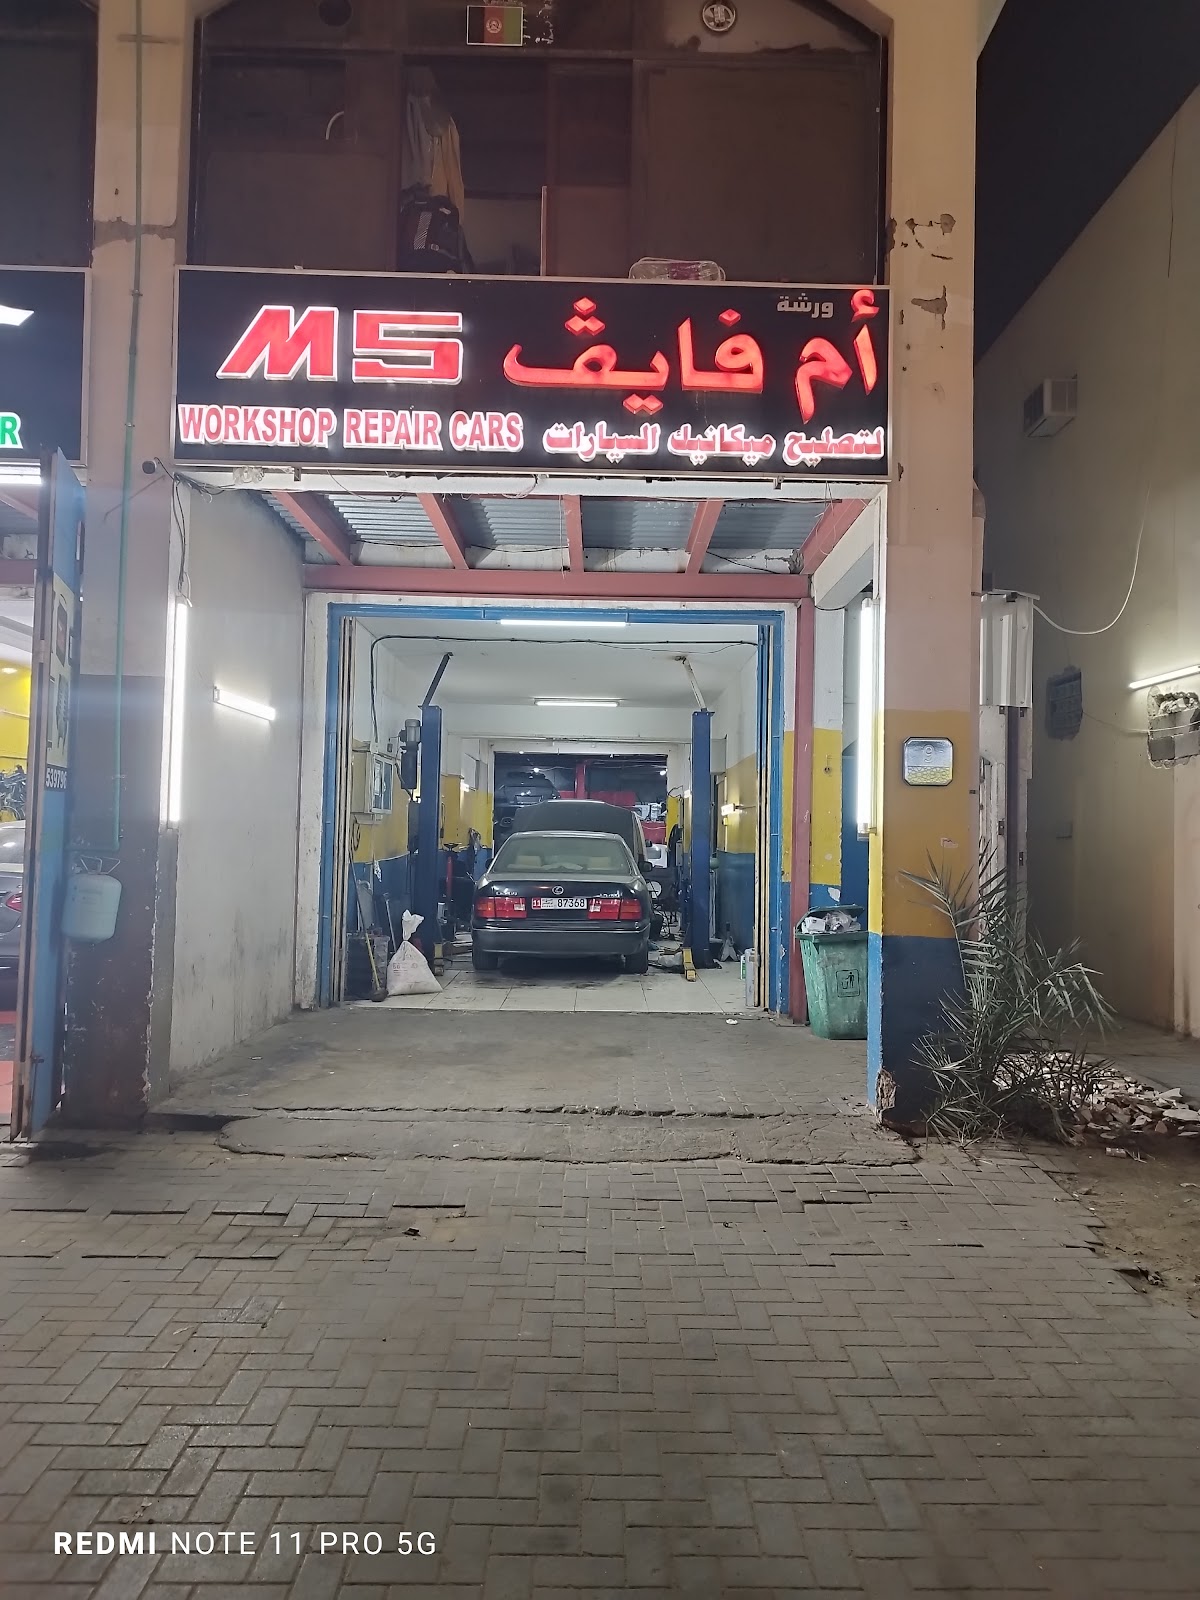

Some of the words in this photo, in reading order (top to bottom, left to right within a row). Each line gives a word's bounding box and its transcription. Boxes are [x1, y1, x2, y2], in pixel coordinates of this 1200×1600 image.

[776, 292, 834, 319] ورشة
[794, 288, 880, 425] أم
[178, 404, 337, 448] WORKSHOP
[343, 409, 443, 450] REPAIR
[449, 410, 524, 452] CARS
[542, 421, 661, 464] السيارات
[667, 422, 777, 466] ميكانيك
[782, 426, 885, 467] لتصليح
[557, 898, 585, 908] 87368
